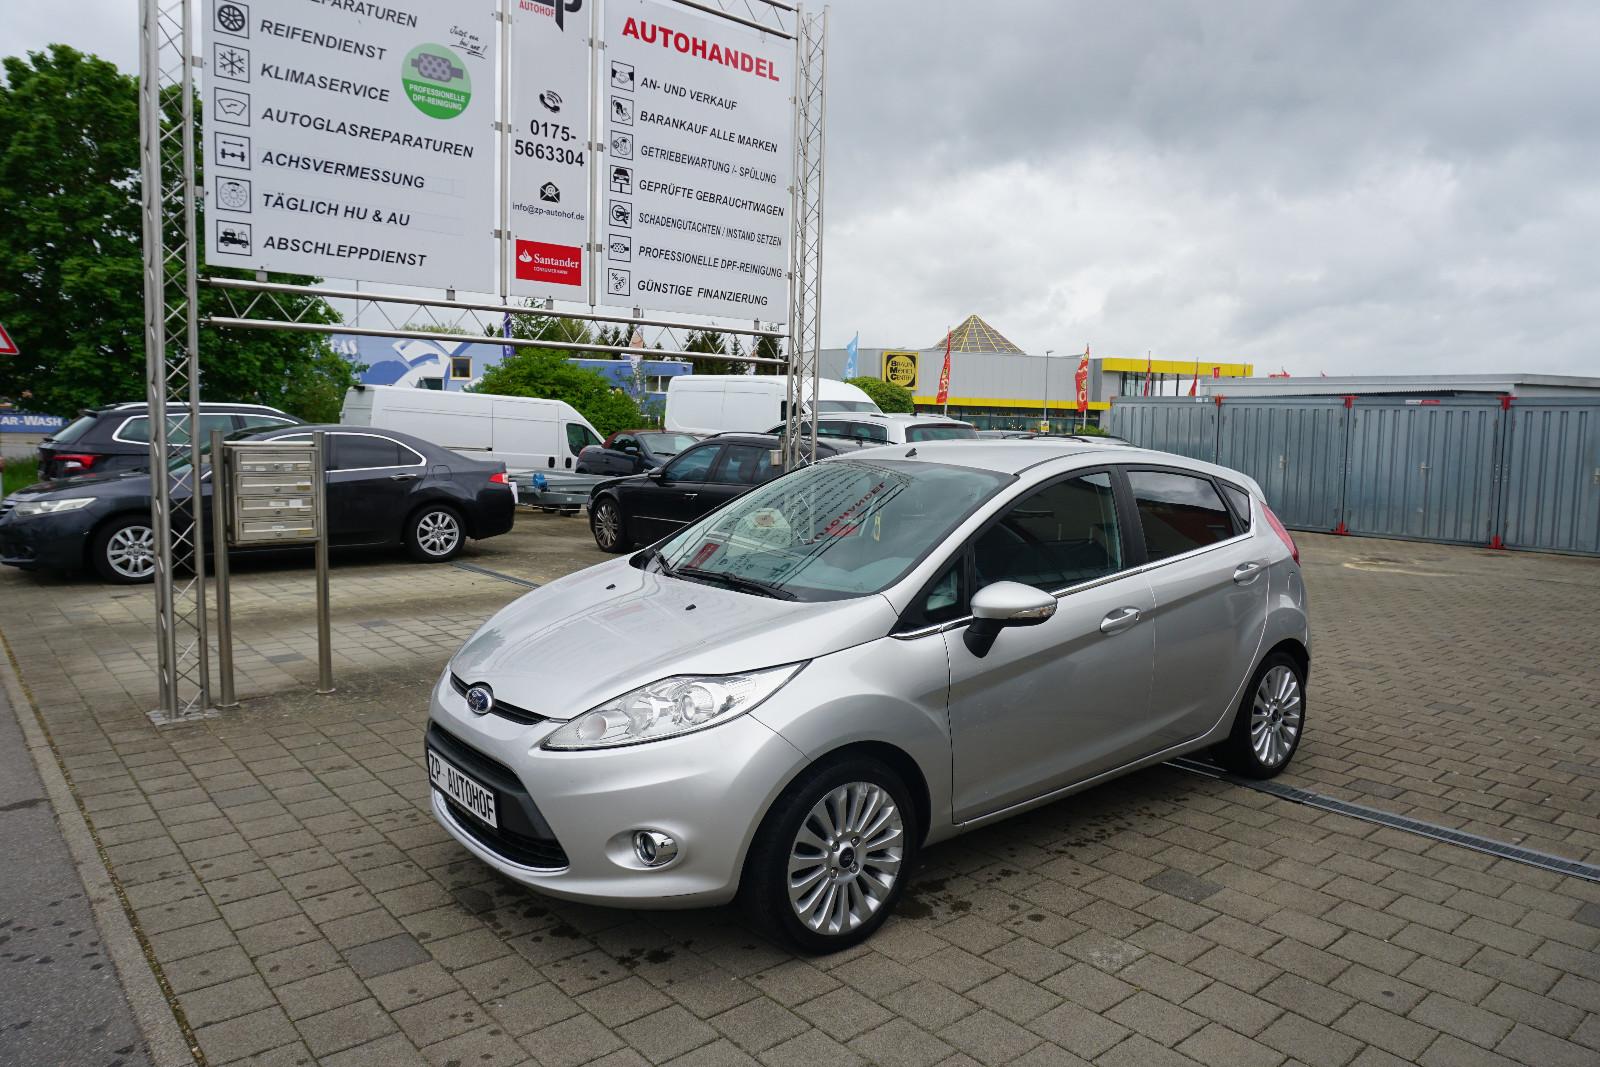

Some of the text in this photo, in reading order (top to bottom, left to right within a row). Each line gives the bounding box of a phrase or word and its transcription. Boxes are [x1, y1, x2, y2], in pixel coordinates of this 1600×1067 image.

[311, 0, 418, 28] ARATUREN
[260, 19, 387, 60] REIFENDIENST
[622, 16, 780, 82] AUTOHANDEL
[261, 63, 390, 102] KLIMASERVICE
[409, 84, 465, 102] PROFESSIONELLE
[641, 77, 738, 111] AN- UND VERKAUF
[262, 107, 474, 158] AUTOGLASREPARATUREN
[530, 119, 577, 142] 0175-
[640, 111, 778, 153] BARANKAUF ALLE MARKEN
[262, 151, 425, 189] ACHSVERMESSUNG
[514, 139, 585, 167] 5663304
[641, 145, 730, 174] GETRIEBEWARTUNG
[739, 166, 777, 184] SPÜLUNG
[263, 192, 410, 226] TÄGLICH HU & AU
[512, 202, 585, 221] info@zp-autohof.de
[639, 179, 784, 217] GEPRÜFTE GEBRAUCHTWAGEN
[638, 212, 721, 236] SCHADENGUTACHTEN
[726, 227, 755, 242] INSTAND
[756, 235, 782, 247] SETZEN
[264, 236, 427, 267] ABSCHLEPPDIENST
[534, 253, 579, 269] Santander
[638, 246, 782, 278] PROFESSIONELLE DPF-REINIGUNG
[637, 279, 768, 306] GÜNSTIGE FINANZIERUNG
[430, 753, 440, 781] ZP
[448, 768, 493, 820] AUTOHOF
